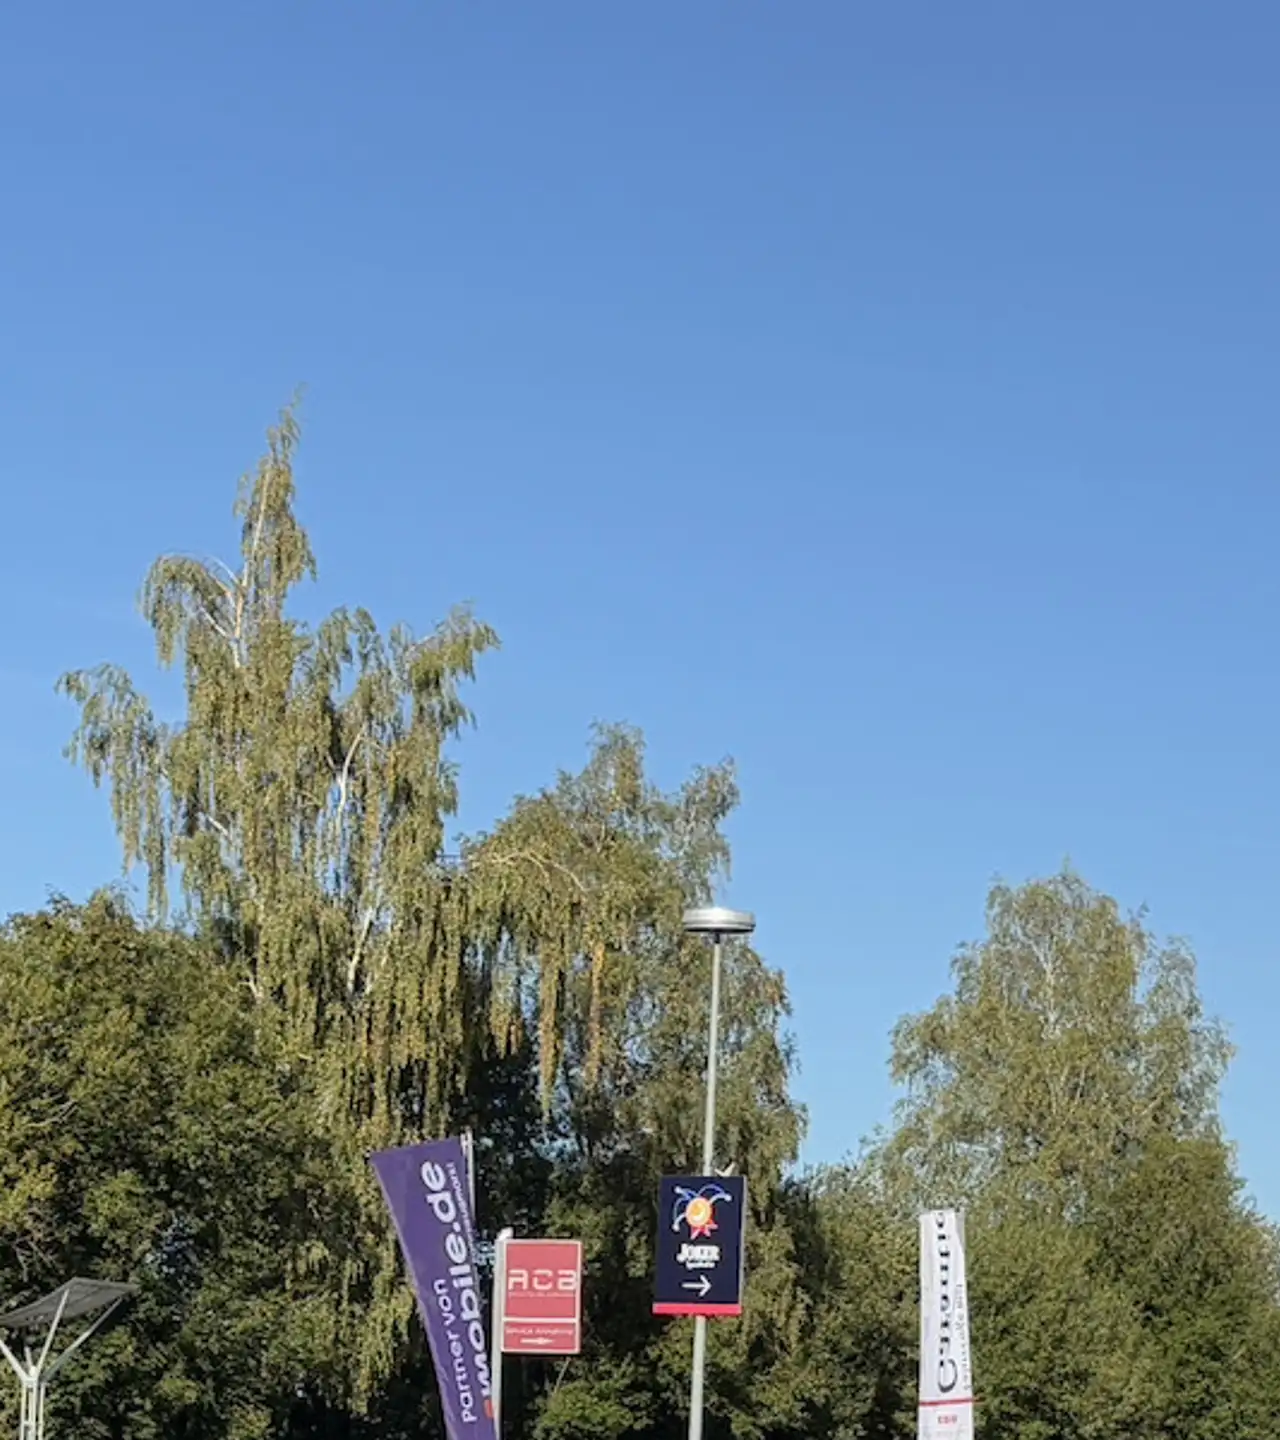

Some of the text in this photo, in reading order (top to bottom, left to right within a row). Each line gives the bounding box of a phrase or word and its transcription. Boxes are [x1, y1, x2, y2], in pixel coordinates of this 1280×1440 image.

[421, 1159, 493, 1398] mobile.de
[433, 1278, 478, 1424] Partner von
